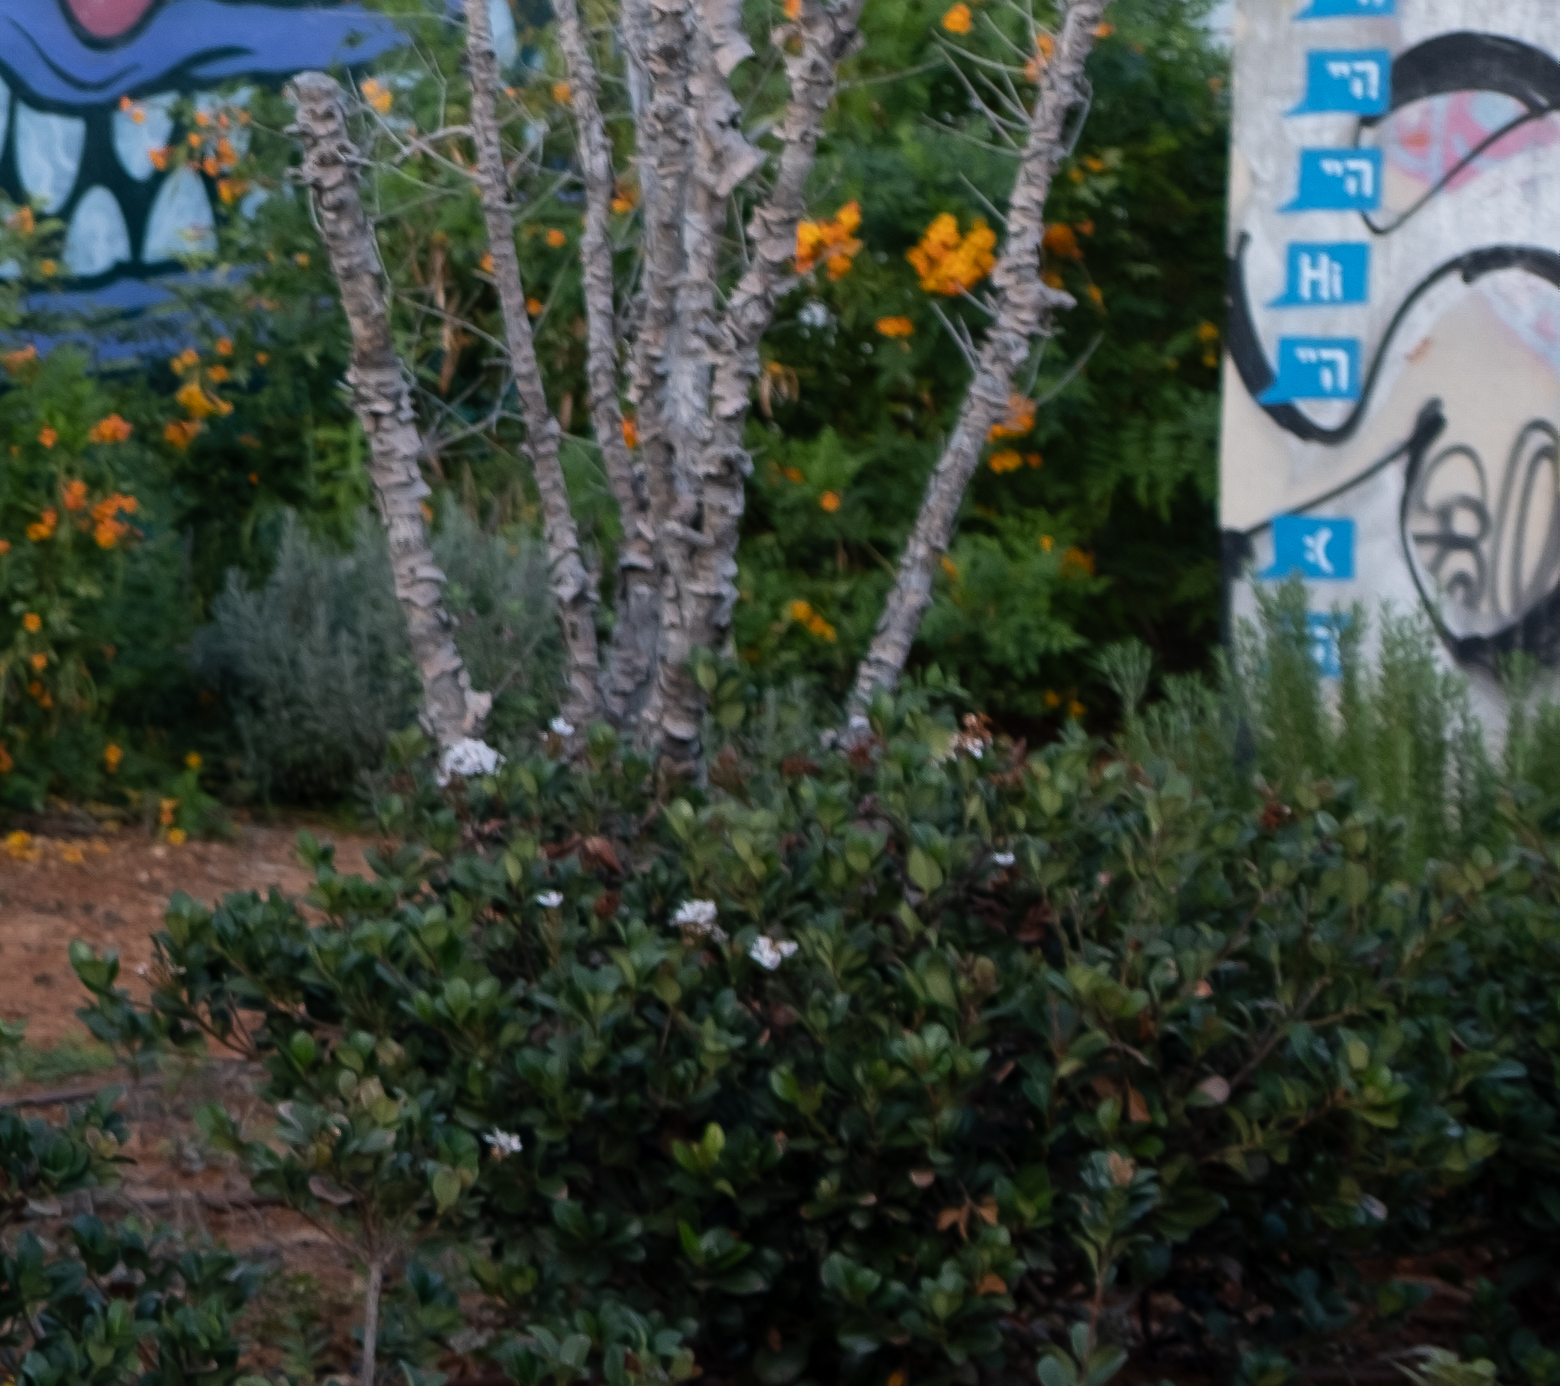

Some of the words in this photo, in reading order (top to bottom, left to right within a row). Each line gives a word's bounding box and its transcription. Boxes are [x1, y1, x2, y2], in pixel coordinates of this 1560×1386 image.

[1324, 59, 1381, 101] היי
[1320, 158, 1374, 197] היי
[1298, 251, 1343, 301] Hi
[1294, 347, 1350, 393] היי
